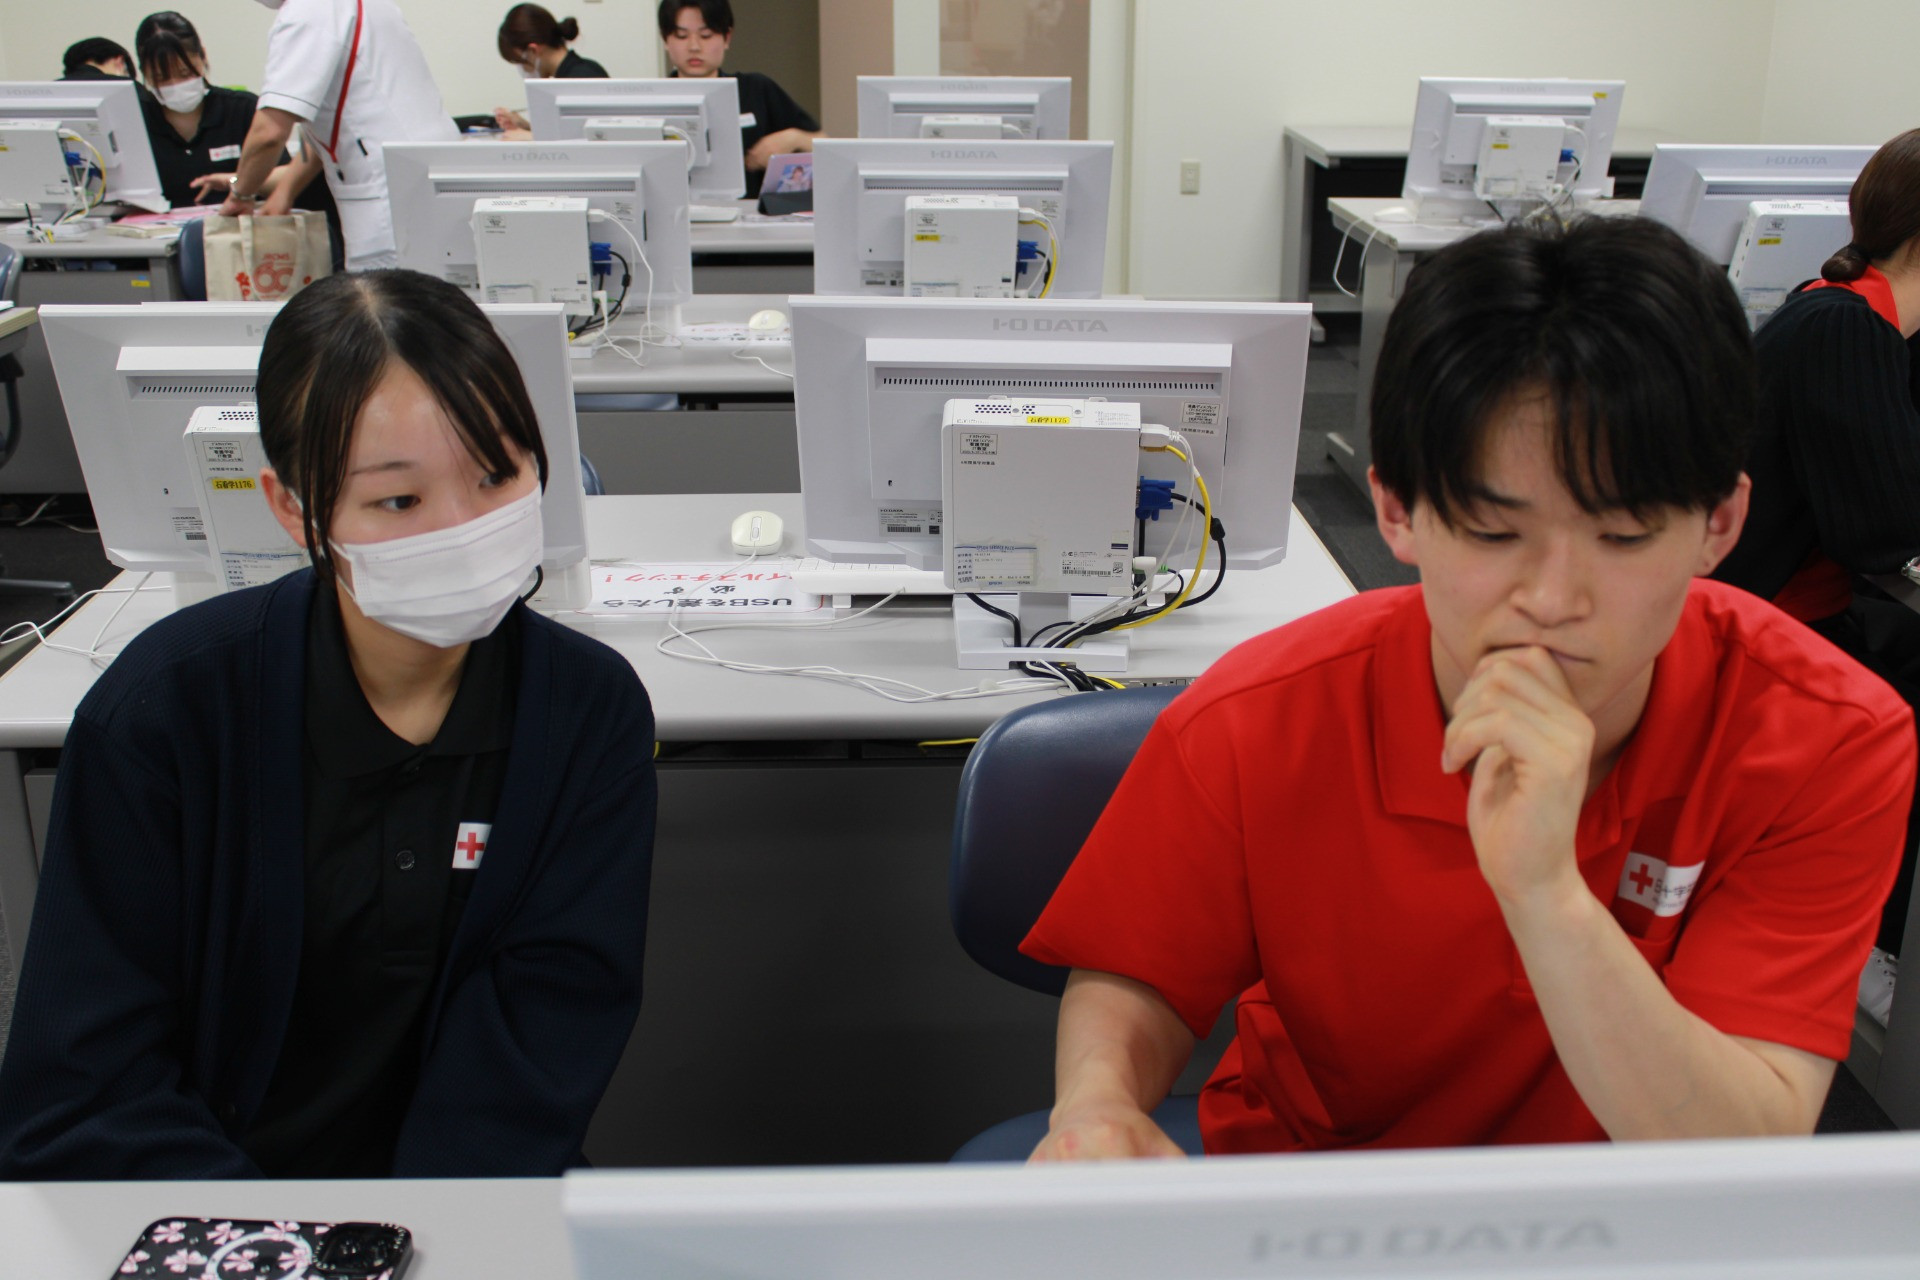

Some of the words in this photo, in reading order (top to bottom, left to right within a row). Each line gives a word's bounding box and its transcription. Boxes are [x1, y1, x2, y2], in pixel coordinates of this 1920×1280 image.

[527, 152, 570, 161] DATA
[955, 150, 998, 159] DATA
[1787, 156, 1828, 165] DATA
[1034, 318, 1108, 332] DATA
[604, 572, 793, 583] イルスチェック！
[1383, 1219, 1617, 1259] DATA
